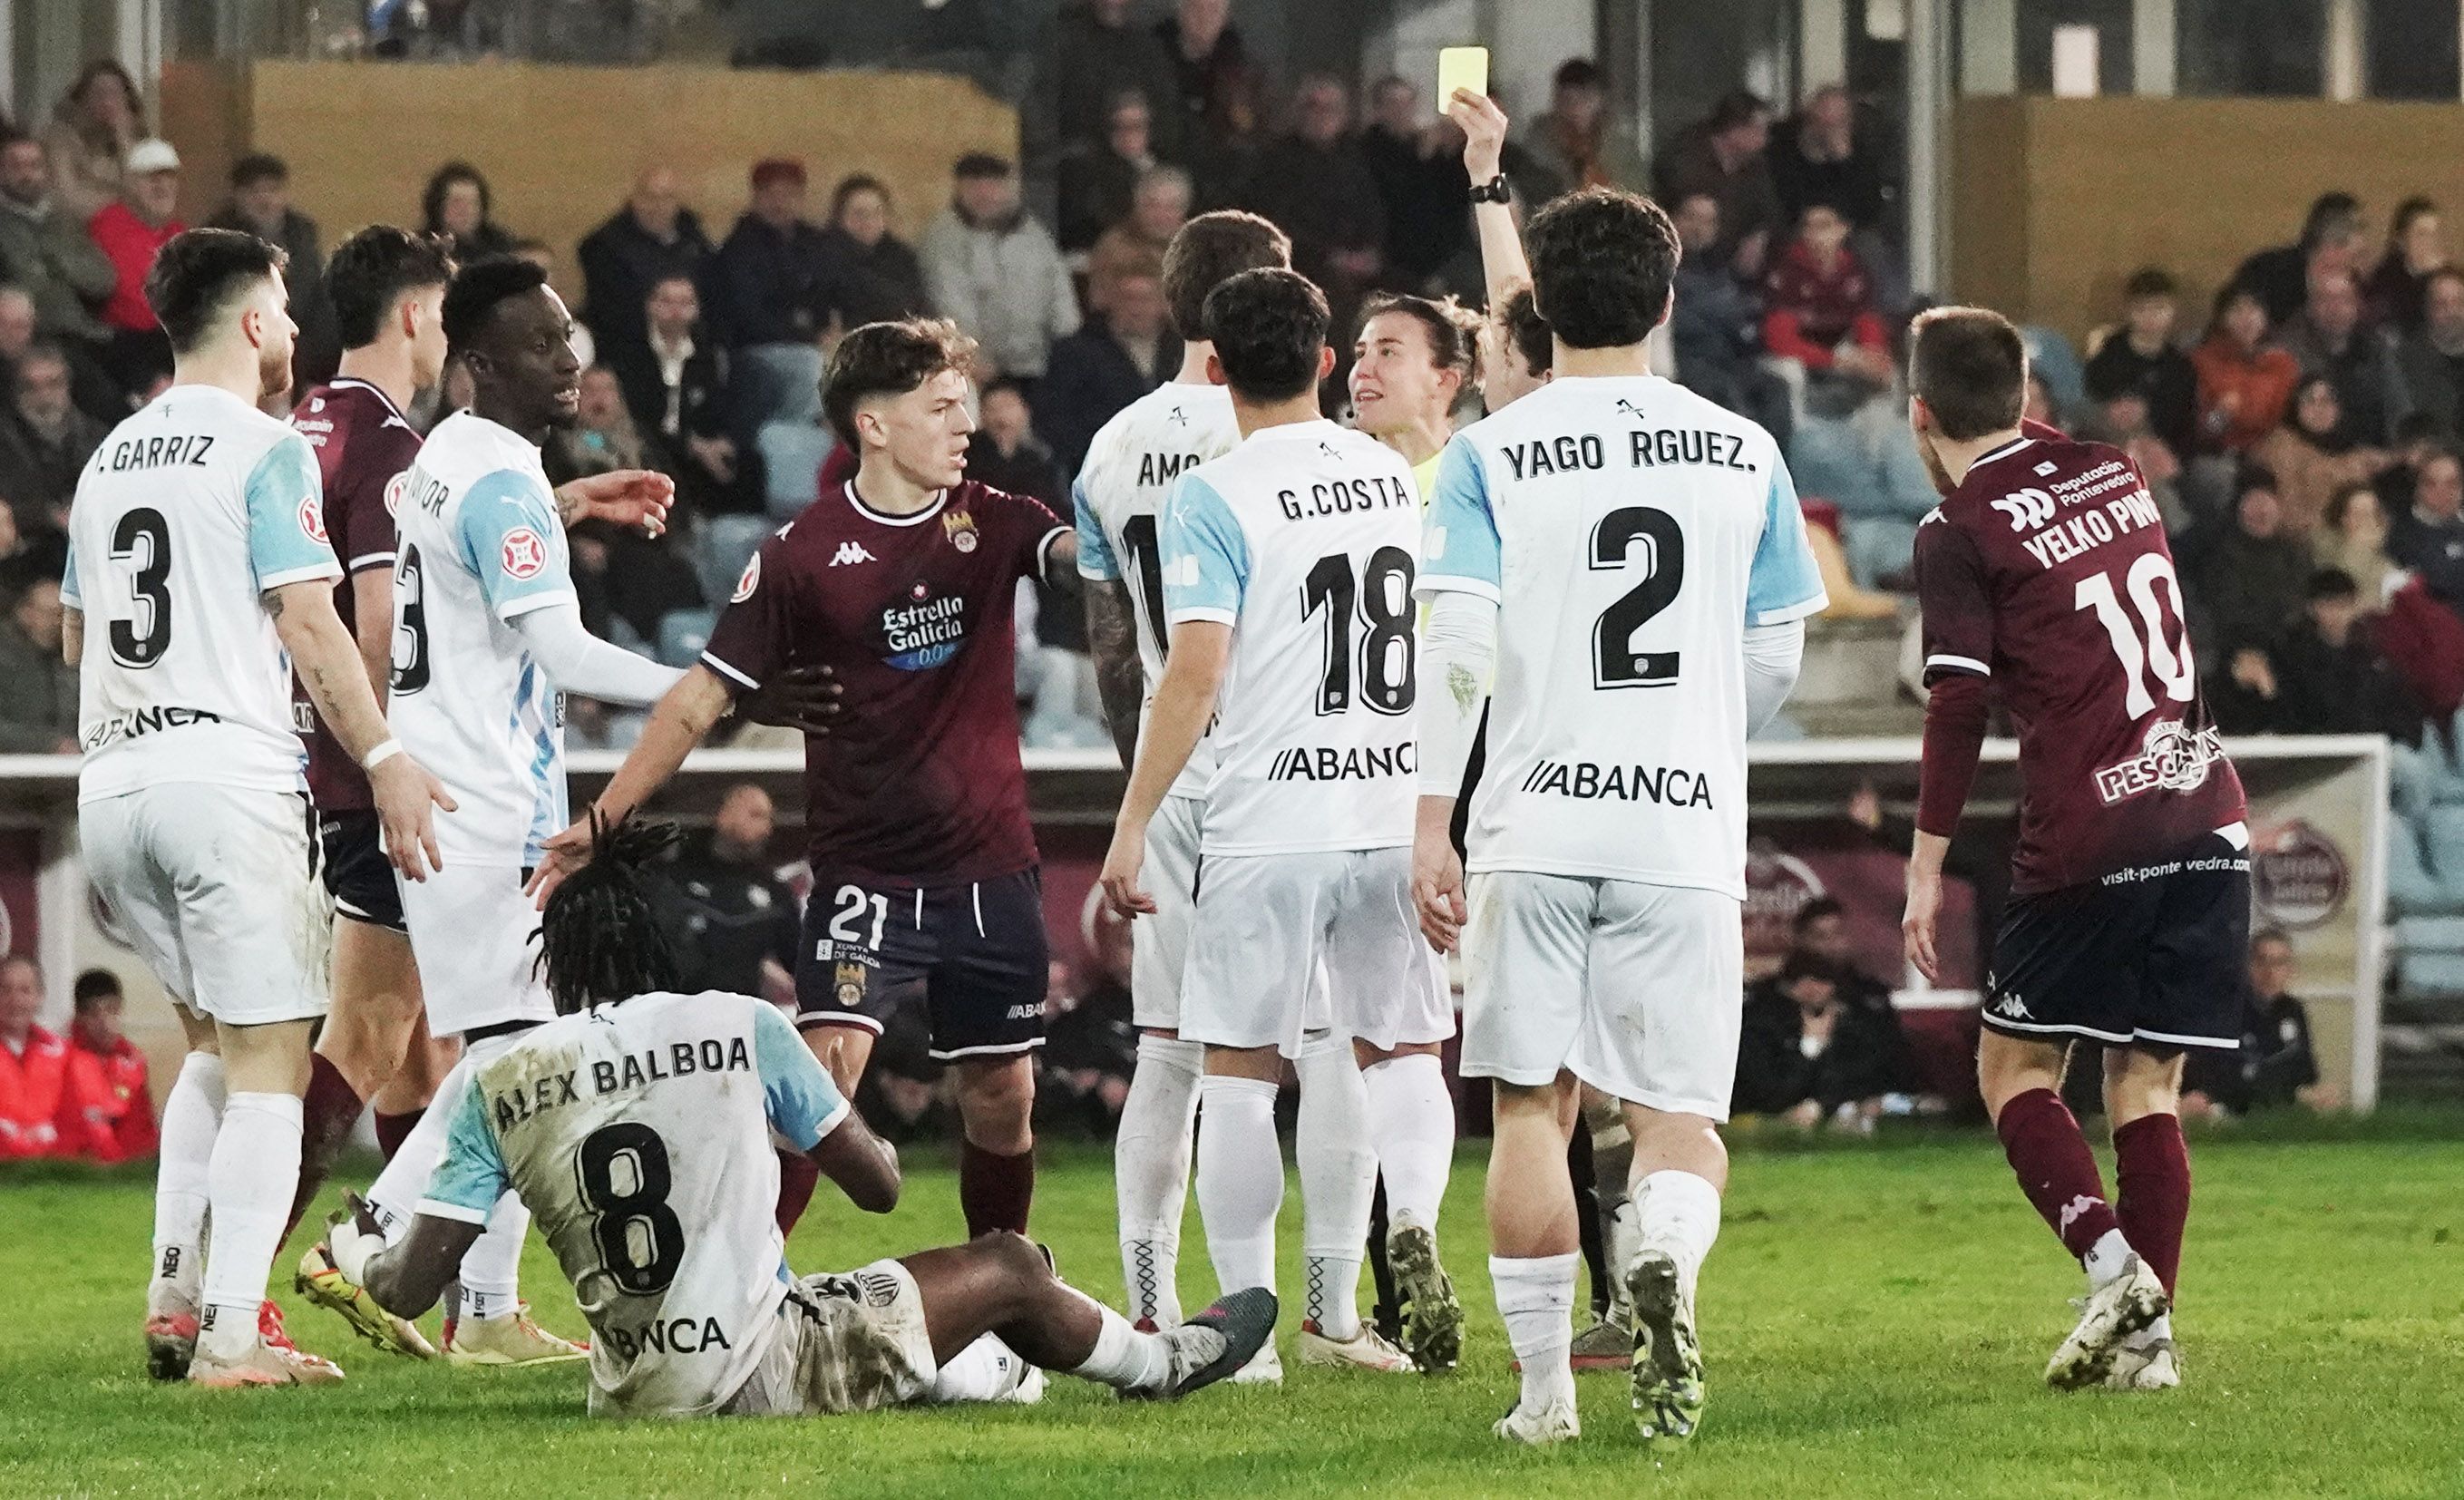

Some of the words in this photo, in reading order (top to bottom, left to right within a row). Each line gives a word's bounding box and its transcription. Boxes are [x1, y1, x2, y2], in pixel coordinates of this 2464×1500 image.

[112, 435, 214, 473] GARRIZ
[1502, 433, 1605, 482] YAGO
[1631, 429, 1757, 472] RGUEZ.
[1278, 476, 1410, 522] G.COSTA
[2021, 510, 2113, 570] YELKO
[108, 506, 172, 669] 3
[883, 597, 963, 631] Estrella
[1589, 506, 1684, 691] 2
[888, 617, 963, 652] Galicia
[1300, 546, 1416, 716] 18
[2075, 553, 2196, 720] 10
[829, 884, 888, 951] 21
[590, 1037, 750, 1096] BALBOA
[574, 1122, 685, 1296] 8
[200, 1303, 217, 1332] NE
